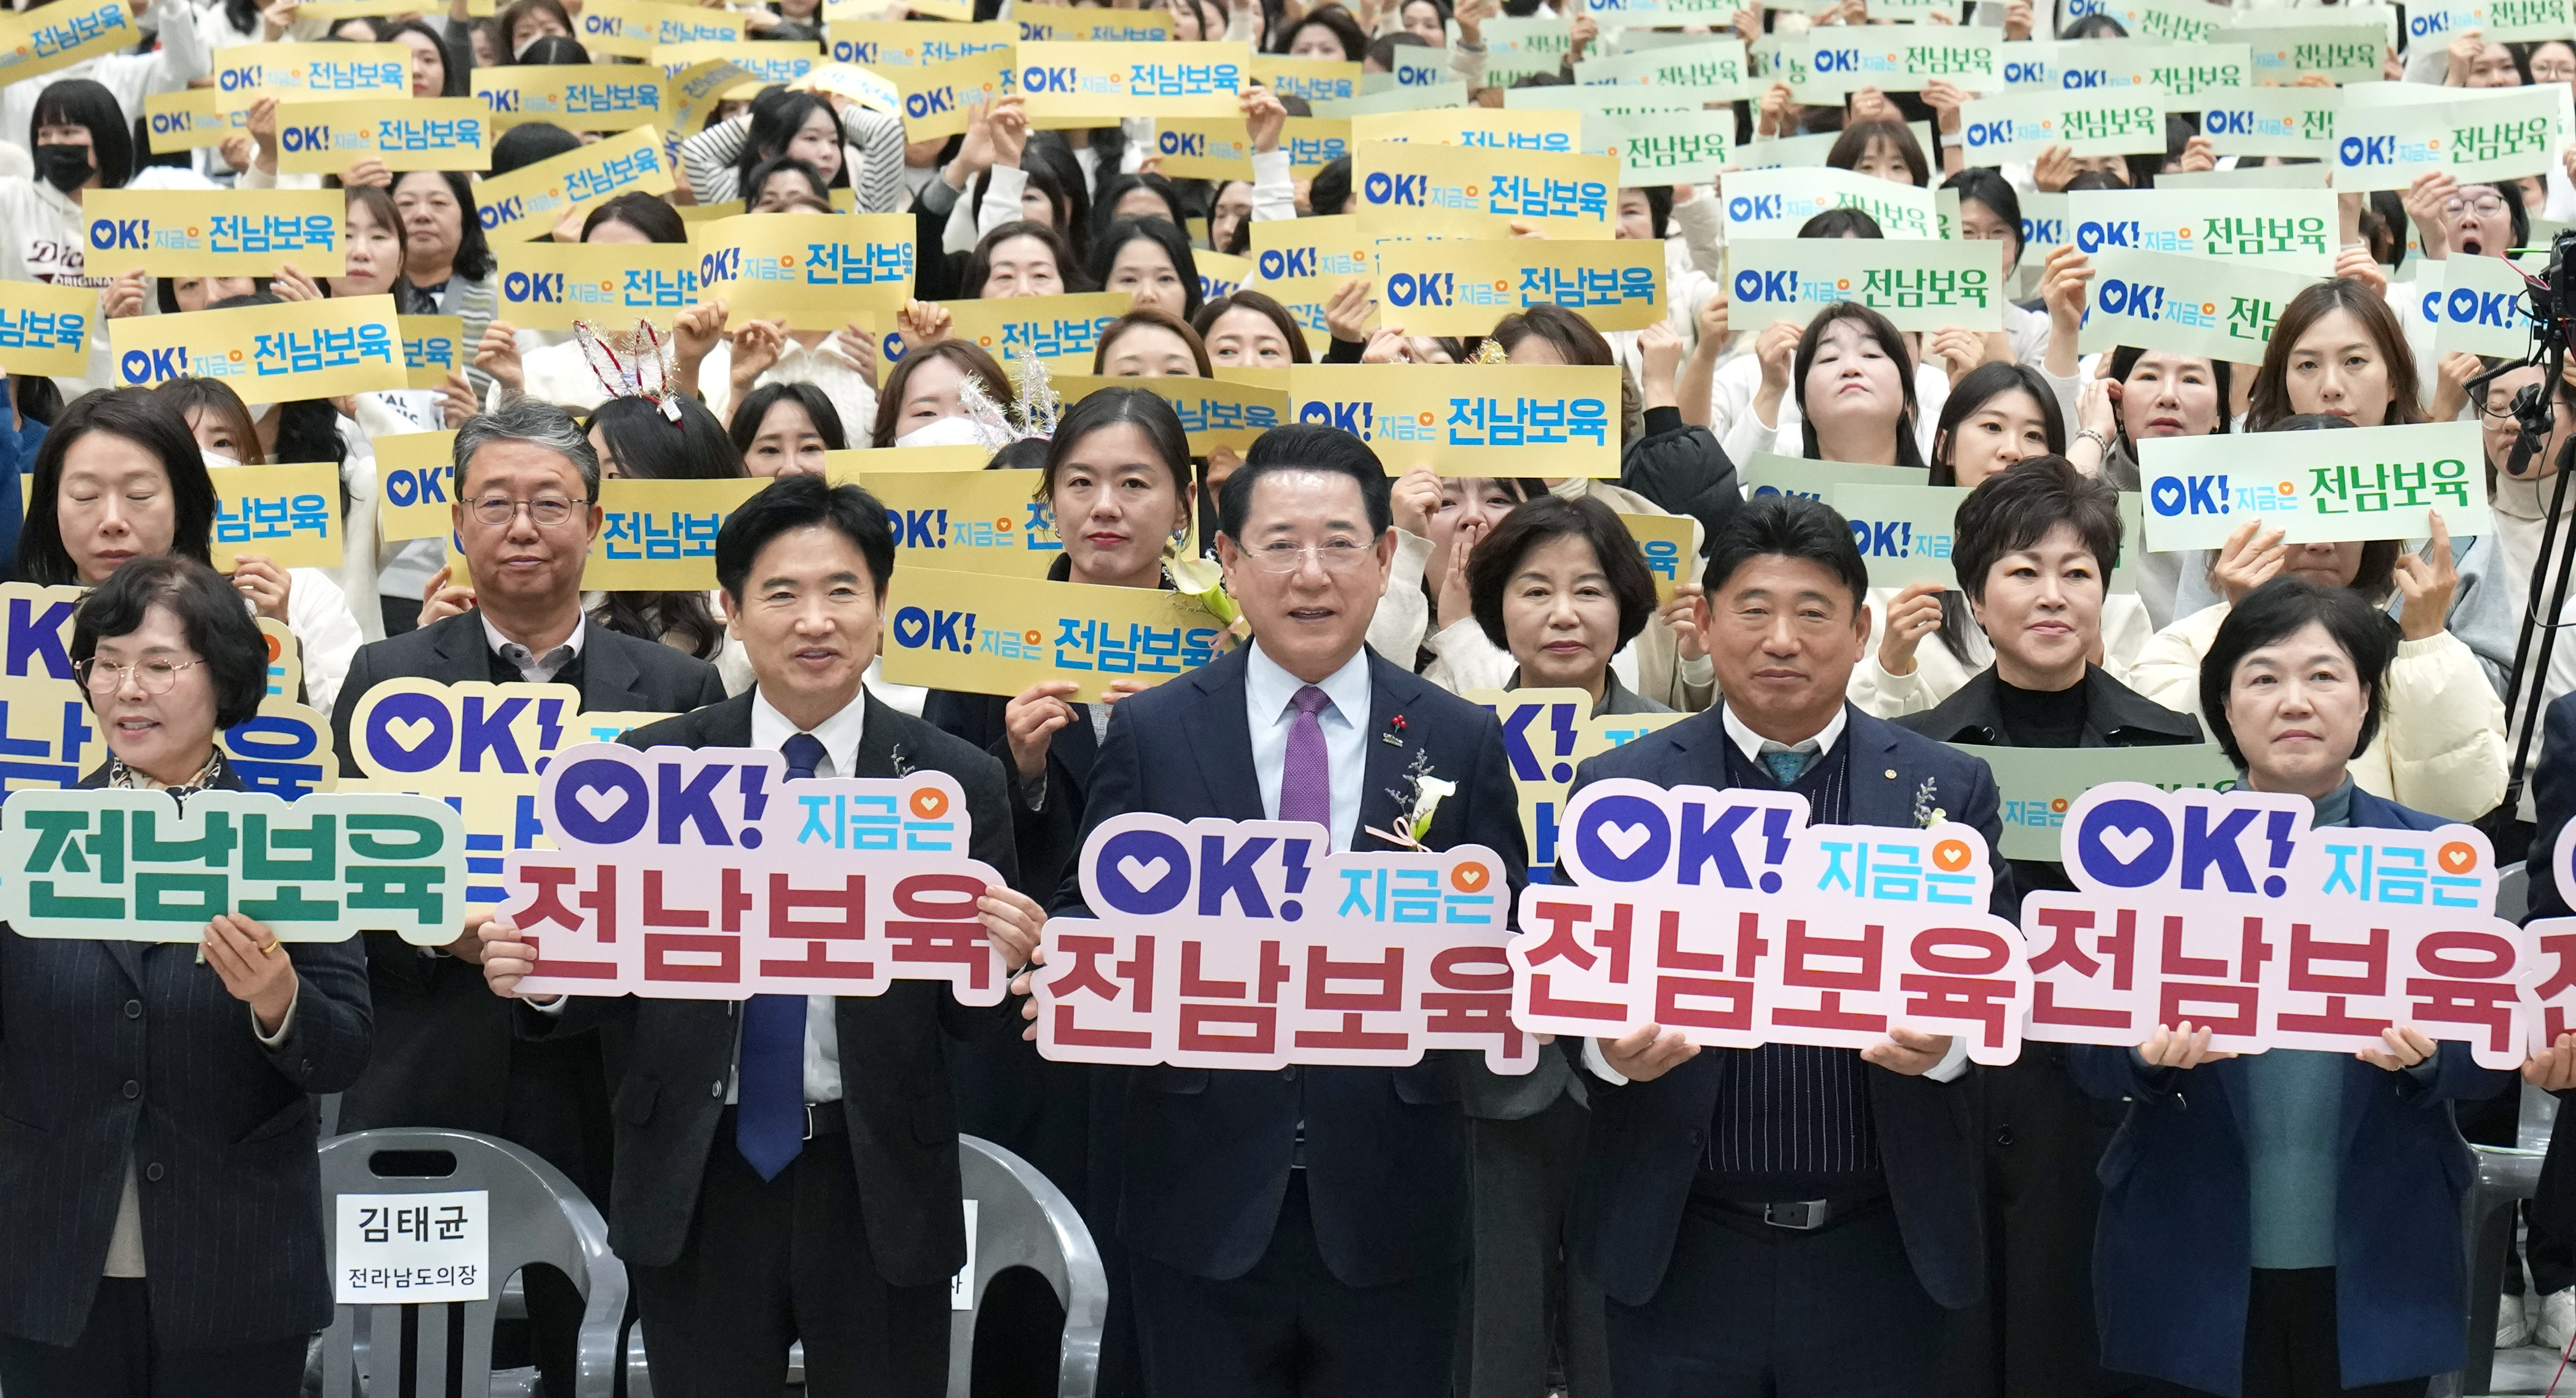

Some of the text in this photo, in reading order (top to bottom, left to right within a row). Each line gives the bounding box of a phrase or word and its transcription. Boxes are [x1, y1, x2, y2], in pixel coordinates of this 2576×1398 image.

[32, 4, 126, 58] 전남보육
[586, 15, 622, 37] OK!
[2411, 11, 2449, 36] OK!
[2490, 0, 2565, 27] 전남보육
[834, 41, 877, 64] OK!
[1815, 50, 1859, 72] OK!
[1905, 46, 1992, 75] 전남보육
[2295, 44, 2374, 70] 전남보육
[220, 66, 263, 91] OK!
[309, 61, 404, 90] 전남보육
[1023, 67, 1076, 93] OK!
[1080, 73, 1122, 93] 지금은
[1129, 64, 1240, 95] 전남보육
[1398, 66, 1436, 86] OK!
[1657, 60, 1738, 86] 전남보육
[2005, 63, 2044, 83] OK!
[2063, 70, 2106, 89] OK!
[565, 83, 661, 113] 전남보육
[906, 86, 955, 118] OK!
[153, 111, 191, 134] OK!
[283, 119, 481, 152] OK! 지금은 전남보육
[1967, 120, 2012, 147] OK!
[2061, 106, 2155, 141] 전남보육
[2206, 110, 2253, 135] OK!
[2340, 117, 2547, 167] OK! 지금은 전남보육
[1159, 131, 1204, 157] OK!
[1627, 133, 1726, 169] 전남보육
[478, 195, 524, 229] OK!
[563, 147, 660, 203] 전남보육
[1365, 172, 1608, 222] OK! 지금은 전남보육
[1729, 194, 1782, 222] OK!
[91, 215, 335, 253] OK! 지금은 전남보육
[2076, 217, 2326, 255] OK! 지금은 전남보육
[701, 242, 913, 287] OK! 지금은 전남보육
[1259, 247, 1367, 280] OK! 지금은
[504, 271, 564, 303] OK!
[568, 280, 615, 303] 지금은
[1388, 267, 1655, 308] OK! 지금은 전남보육
[1735, 268, 1989, 308] OK! 지금은 전남보육
[2099, 279, 2165, 321] OK!
[2165, 301, 2216, 328] 지금은
[2448, 288, 2517, 329] OK!
[122, 323, 391, 384] OK! 지금은 전남보육
[1168, 398, 1276, 434] 남보육
[1378, 412, 1436, 441] 지금은
[1447, 397, 1608, 447] 전남보육
[386, 466, 454, 507] OK
[2151, 459, 2469, 516] OK! 지금은 전남보육
[603, 511, 733, 561] 전남보
[888, 508, 948, 549] OK!
[953, 517, 1014, 547] 지금은
[1849, 519, 1912, 559] OK!
[893, 606, 976, 654] OK!
[979, 629, 1044, 661] 지금은
[366, 692, 565, 777] OK!
[1480, 704, 1578, 784] K!
[555, 758, 769, 850] OK!
[797, 787, 954, 852] 지금은
[2005, 798, 2068, 827] 지금은
[24, 809, 446, 925] 전남보육
[1576, 794, 1977, 905] OK! 지금은
[2078, 799, 2482, 908] OK! 지금은
[1096, 830, 1495, 924] OK! 지금은
[511, 864, 990, 991] 전남보육
[1524, 901, 2016, 1048] 전남보육
[2027, 908, 2519, 1053] 전남보육
[1047, 935, 1524, 1060] 전남보육
[358, 1205, 468, 1242] 김태균
[349, 1265, 477, 1289] 전라남도의장
